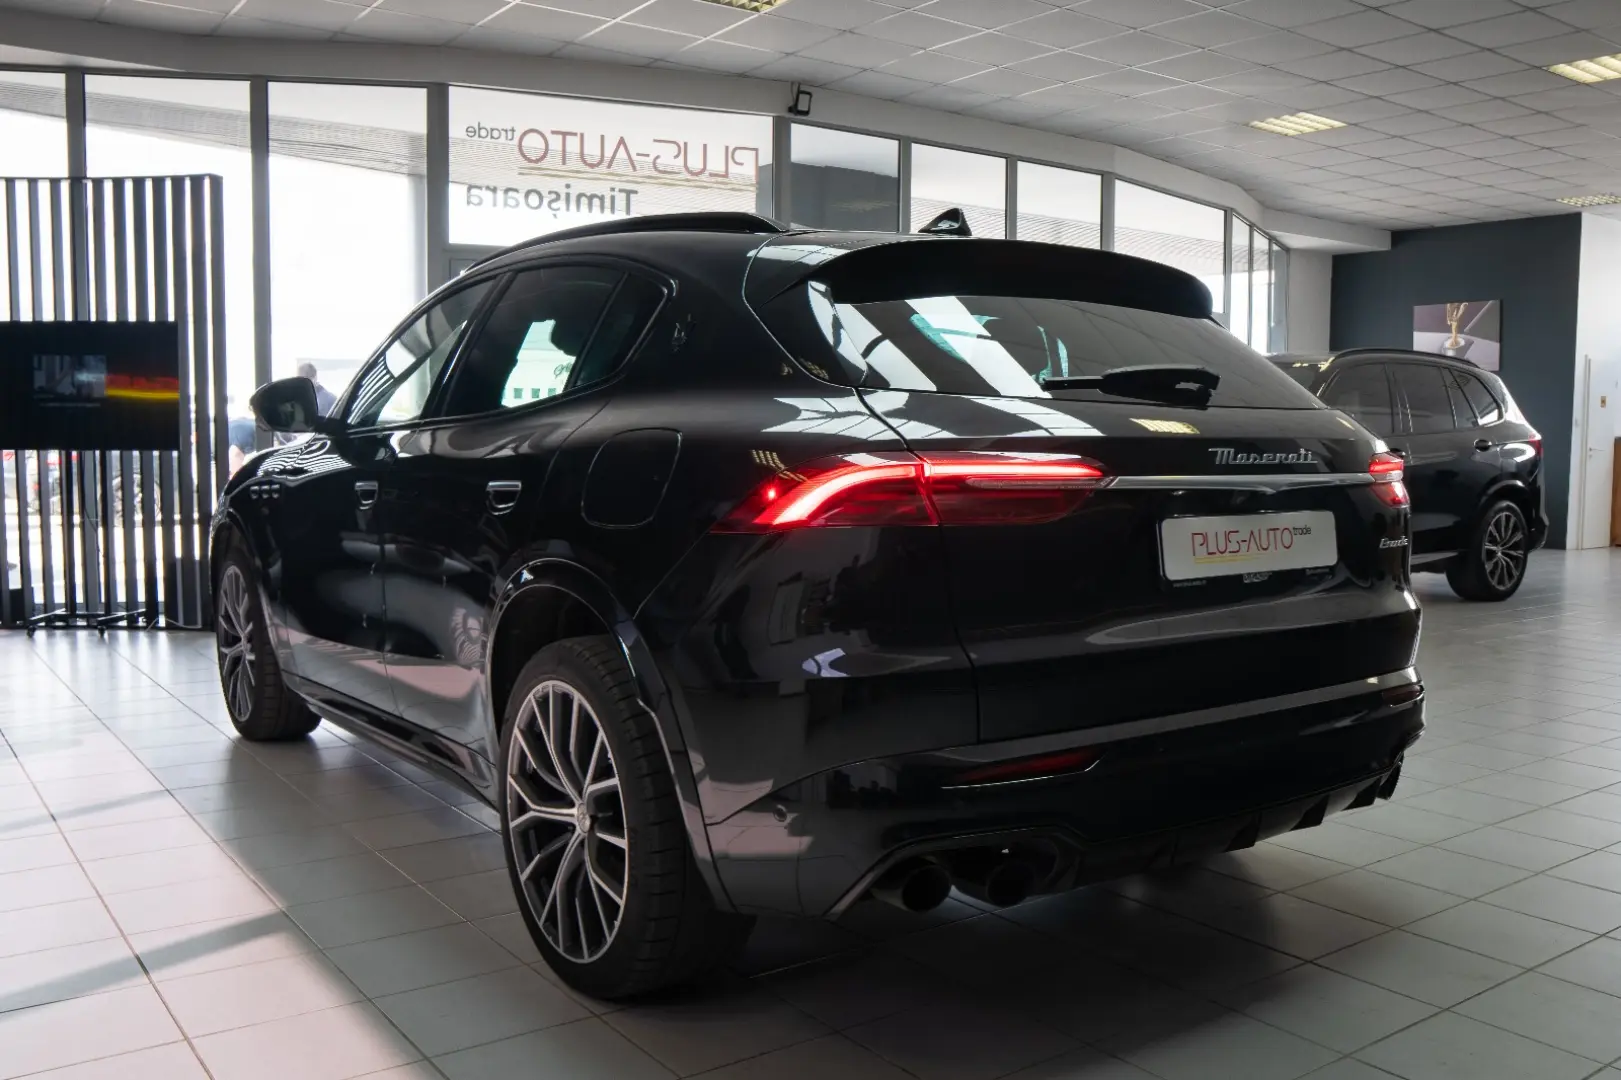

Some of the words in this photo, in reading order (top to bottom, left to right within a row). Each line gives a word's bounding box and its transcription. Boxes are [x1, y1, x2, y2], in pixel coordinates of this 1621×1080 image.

[1208, 448, 1318, 464] Maserati
[1191, 527, 1294, 556] PLUS-AUTO
[1293, 525, 1312, 535] trade
